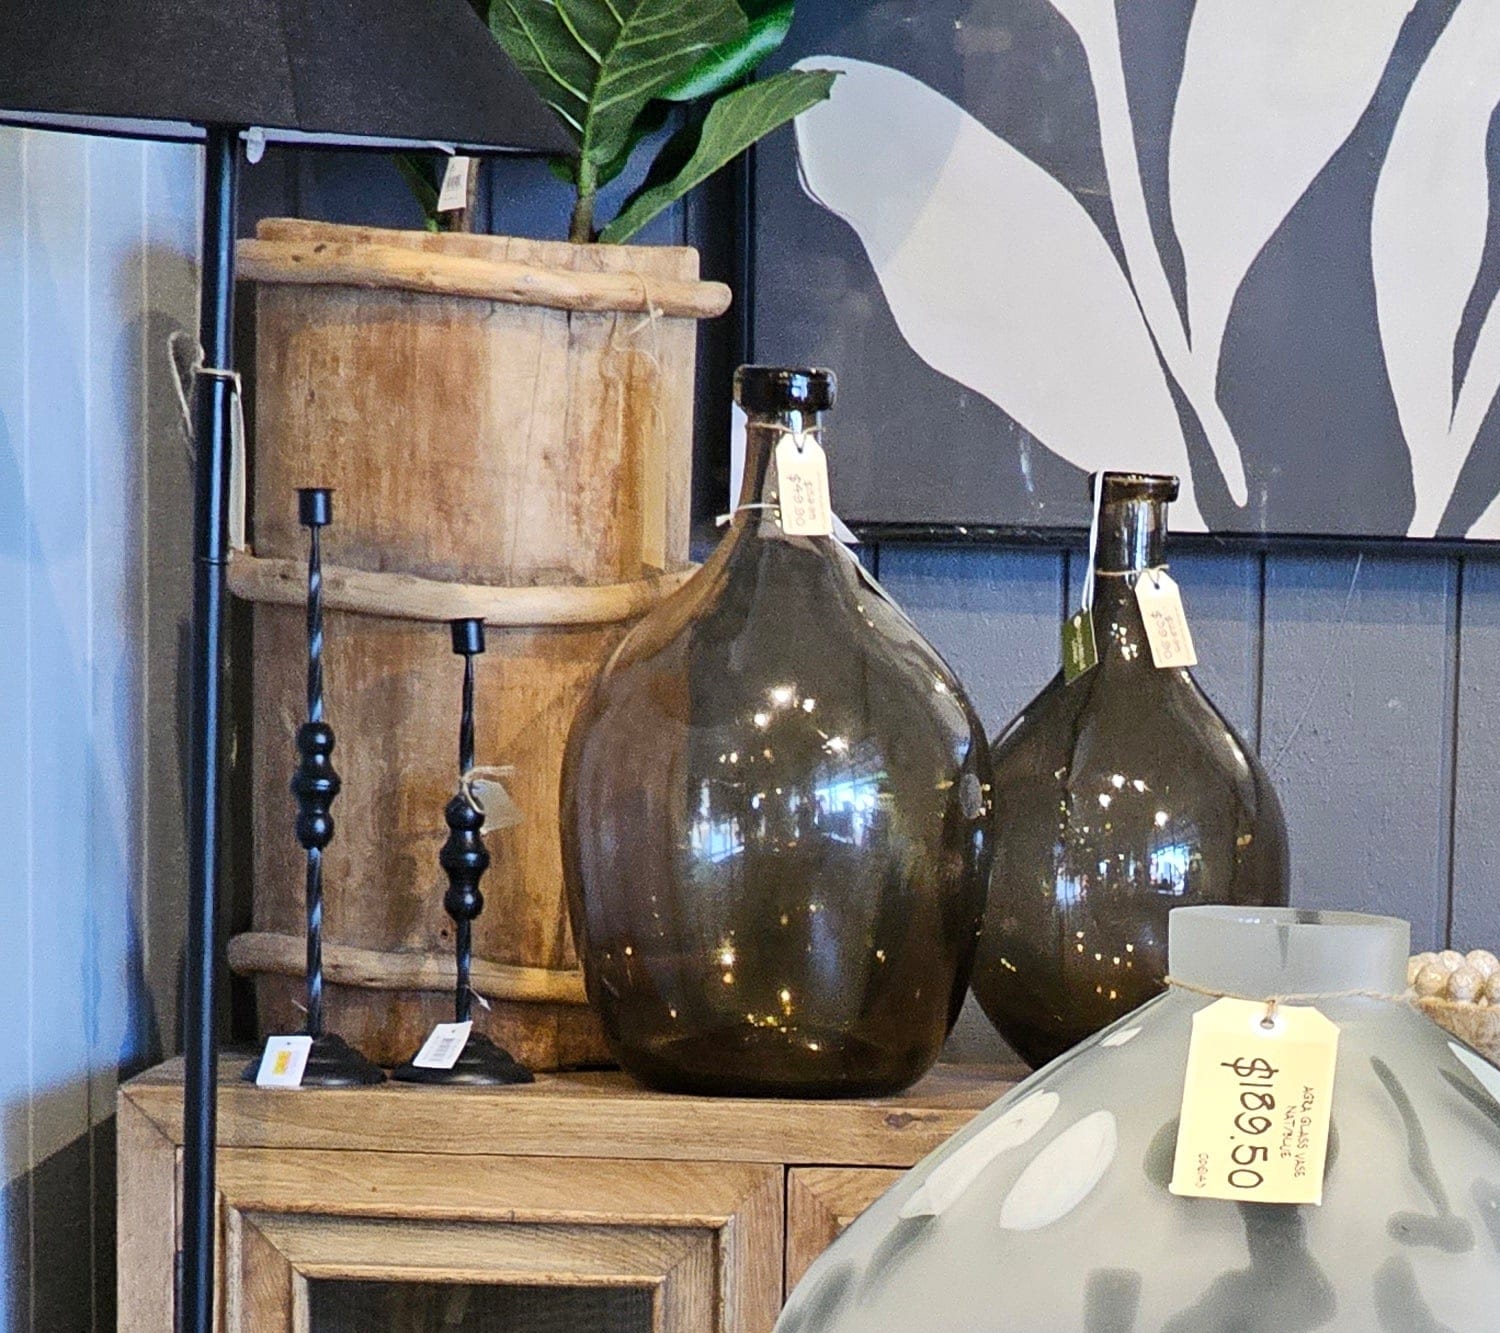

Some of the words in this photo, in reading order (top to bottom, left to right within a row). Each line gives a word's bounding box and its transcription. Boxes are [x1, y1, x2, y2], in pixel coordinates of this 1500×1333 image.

[1303, 1086, 1314, 1112] AGRA
[1220, 1057, 1279, 1189] $189.50
[1297, 1117, 1311, 1149] GLASS
[1294, 1153, 1305, 1177] VASE
